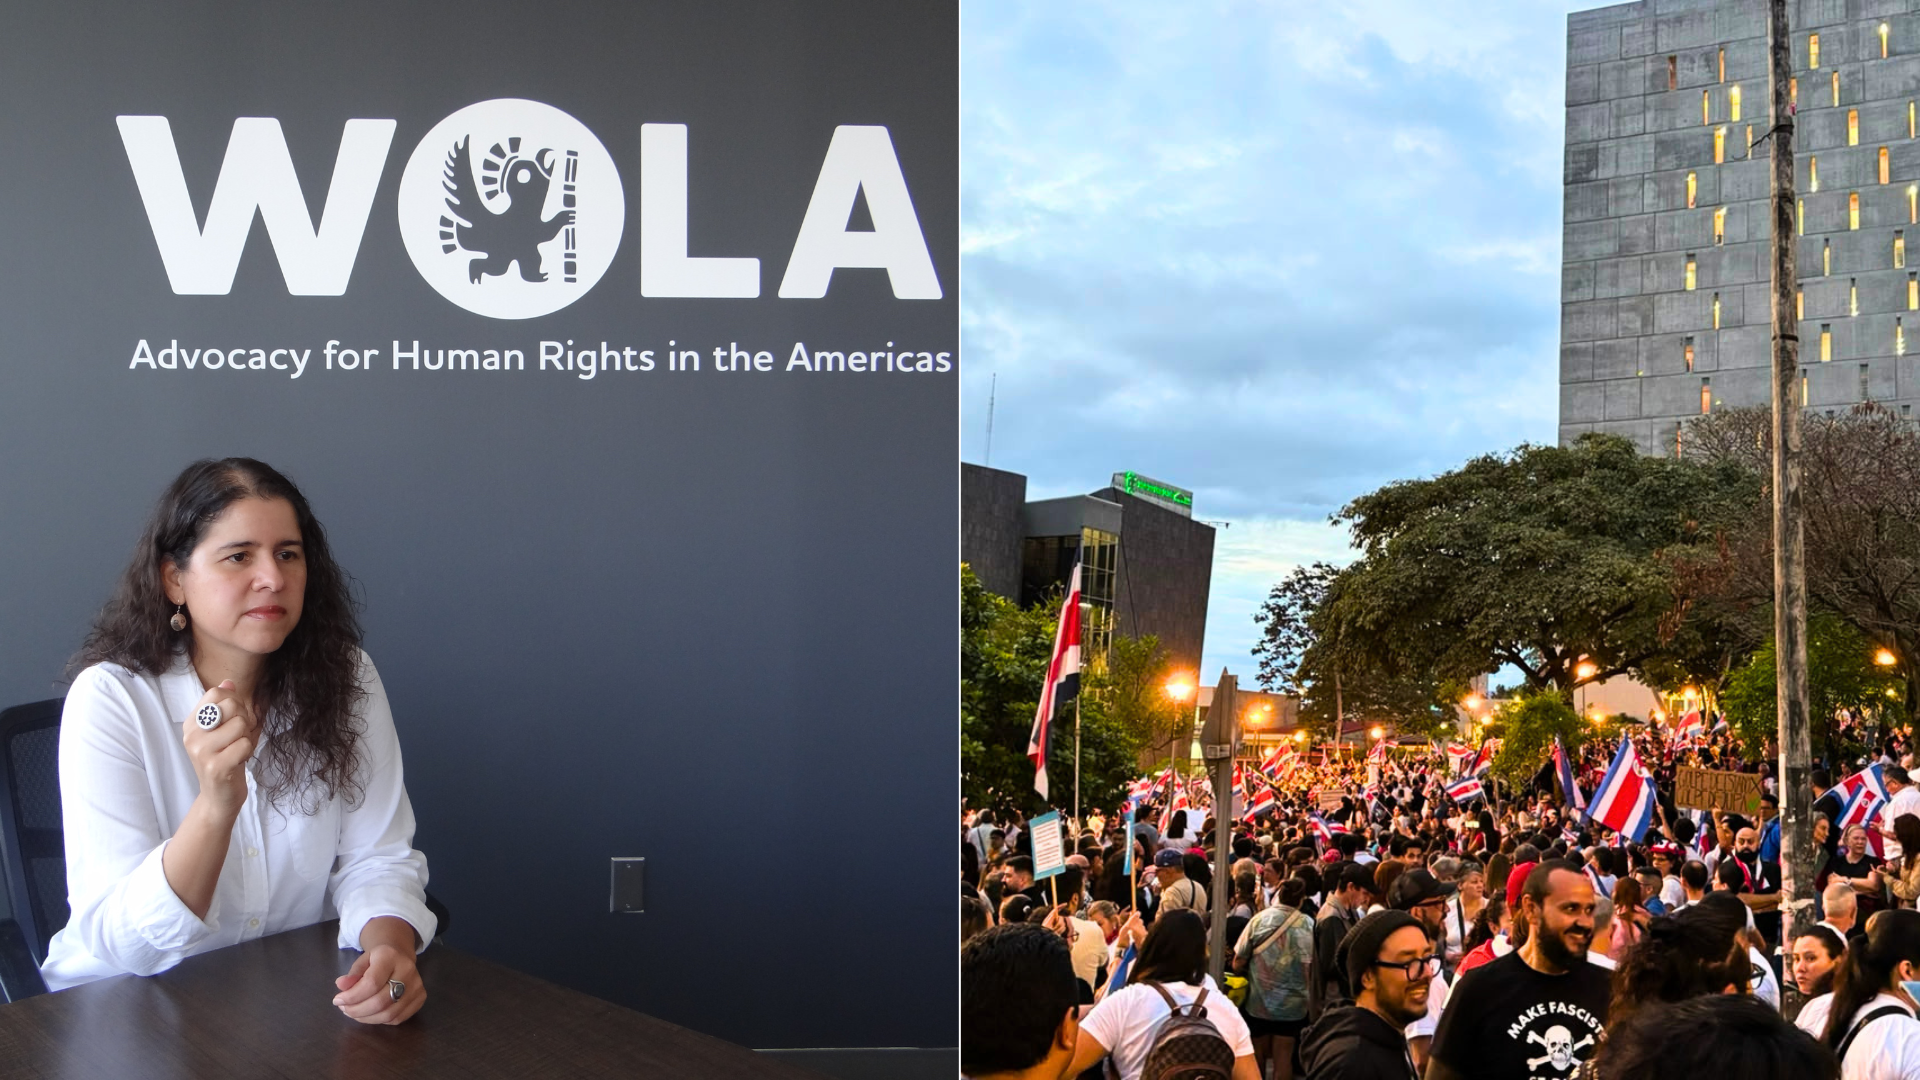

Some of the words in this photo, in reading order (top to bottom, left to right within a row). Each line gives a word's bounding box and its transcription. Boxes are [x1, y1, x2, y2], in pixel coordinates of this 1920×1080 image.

[115, 97, 943, 321] WOLA
[129, 338, 311, 380] Advocacy
[323, 339, 380, 372] for
[392, 340, 525, 372] Human
[539, 340, 656, 381] Rights
[668, 340, 700, 373] in
[712, 341, 774, 373] the
[785, 341, 952, 374] Americas
[1507, 1003, 1547, 1039] MAKE
